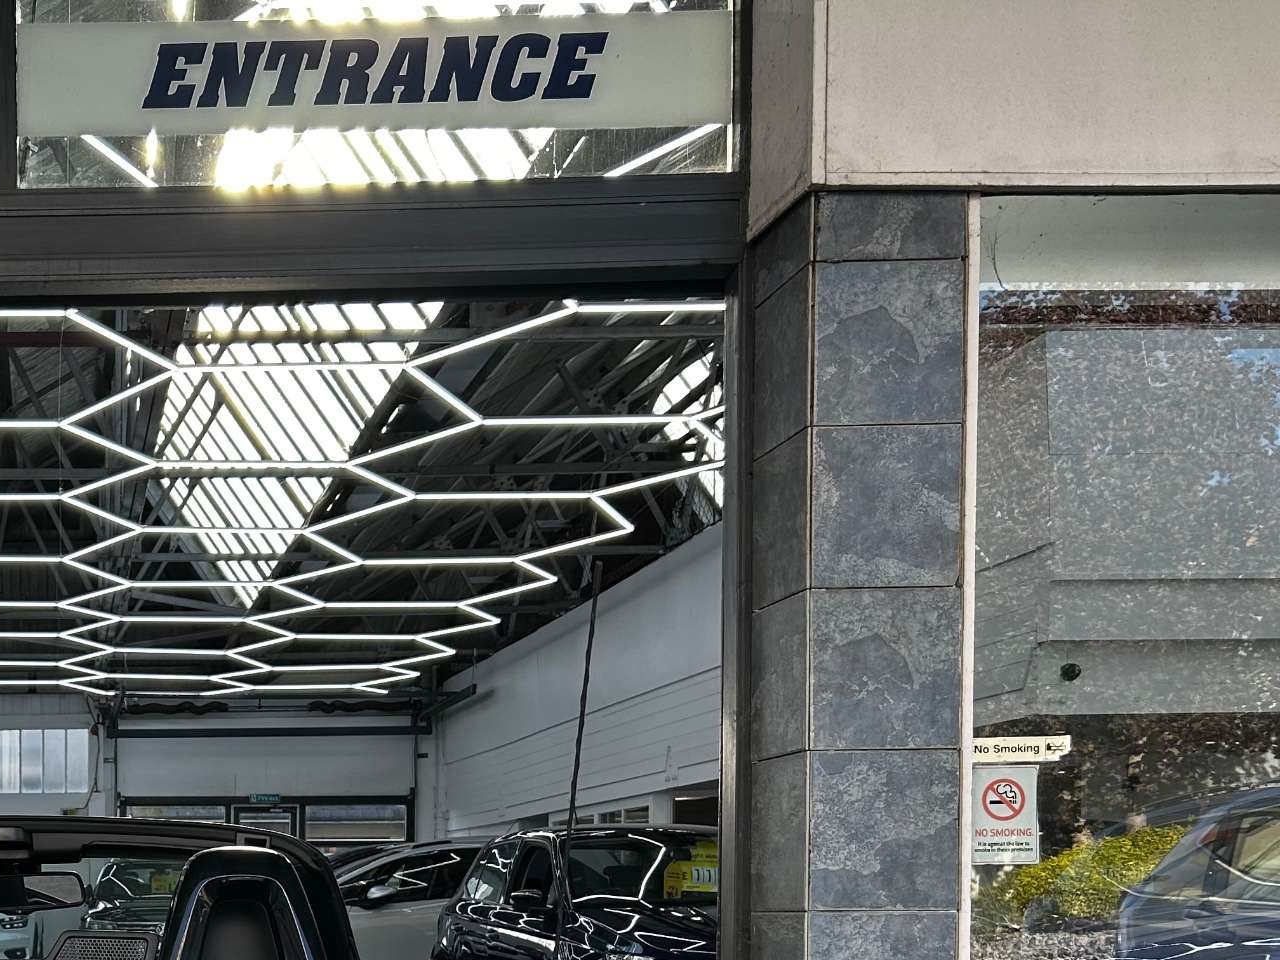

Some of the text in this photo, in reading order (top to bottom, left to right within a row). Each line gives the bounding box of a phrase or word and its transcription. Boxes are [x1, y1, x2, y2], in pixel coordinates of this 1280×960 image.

[141, 31, 610, 109] ENTRANCE
[974, 743, 1040, 755] No Smoking
[975, 828, 988, 837] NO
